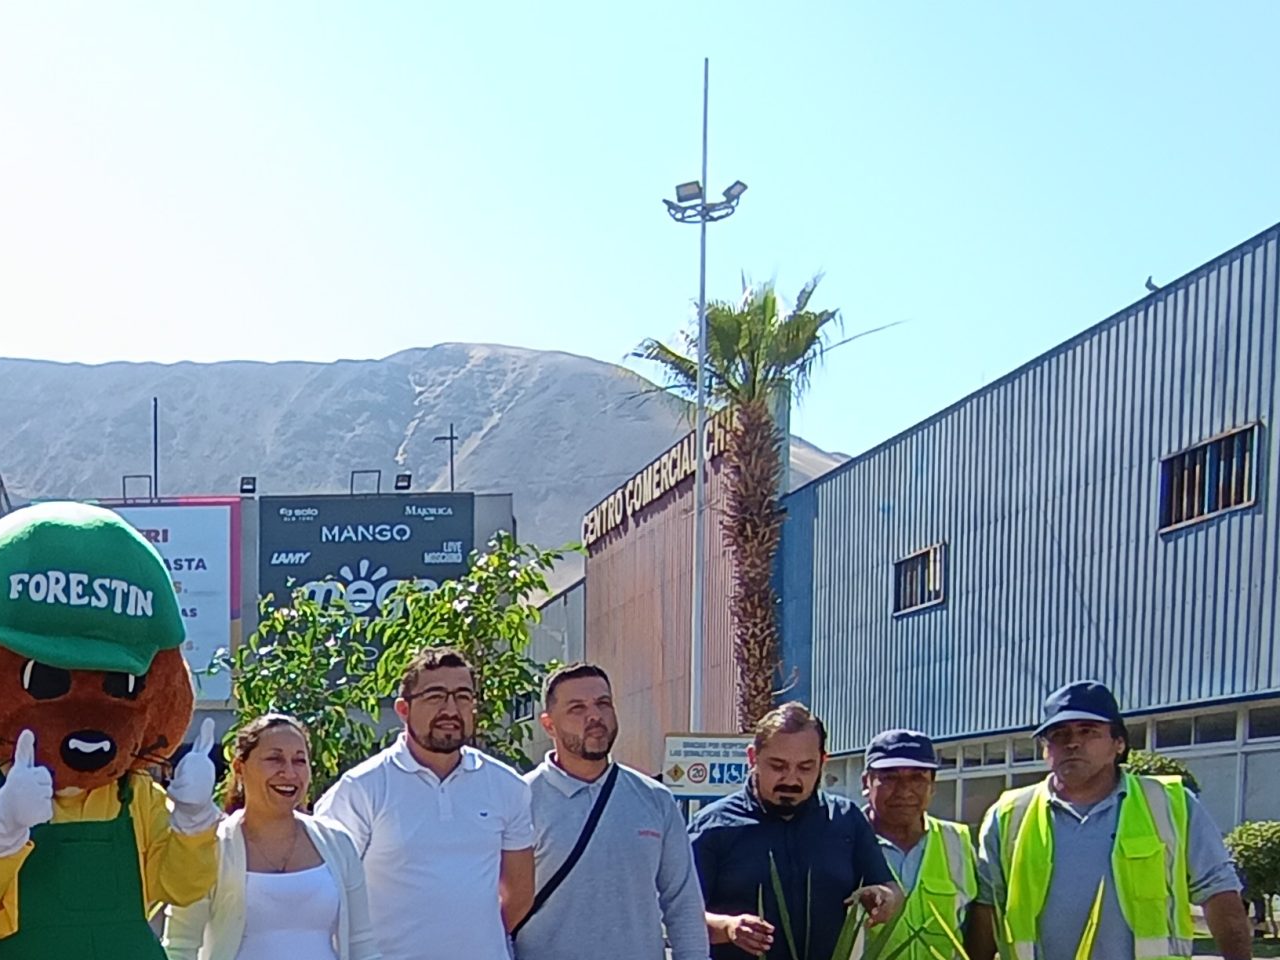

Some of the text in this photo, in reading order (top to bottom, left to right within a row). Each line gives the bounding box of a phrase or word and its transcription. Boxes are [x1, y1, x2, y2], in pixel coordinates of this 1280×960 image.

[581, 489, 624, 548] CENTRO
[625, 433, 697, 516] COMERCIAL
[322, 524, 411, 542] MANGO
[443, 542, 462, 553] LOVE
[271, 552, 311, 564] LAMY
[9, 570, 153, 617] FORESTIN
[692, 768, 704, 778] 20
